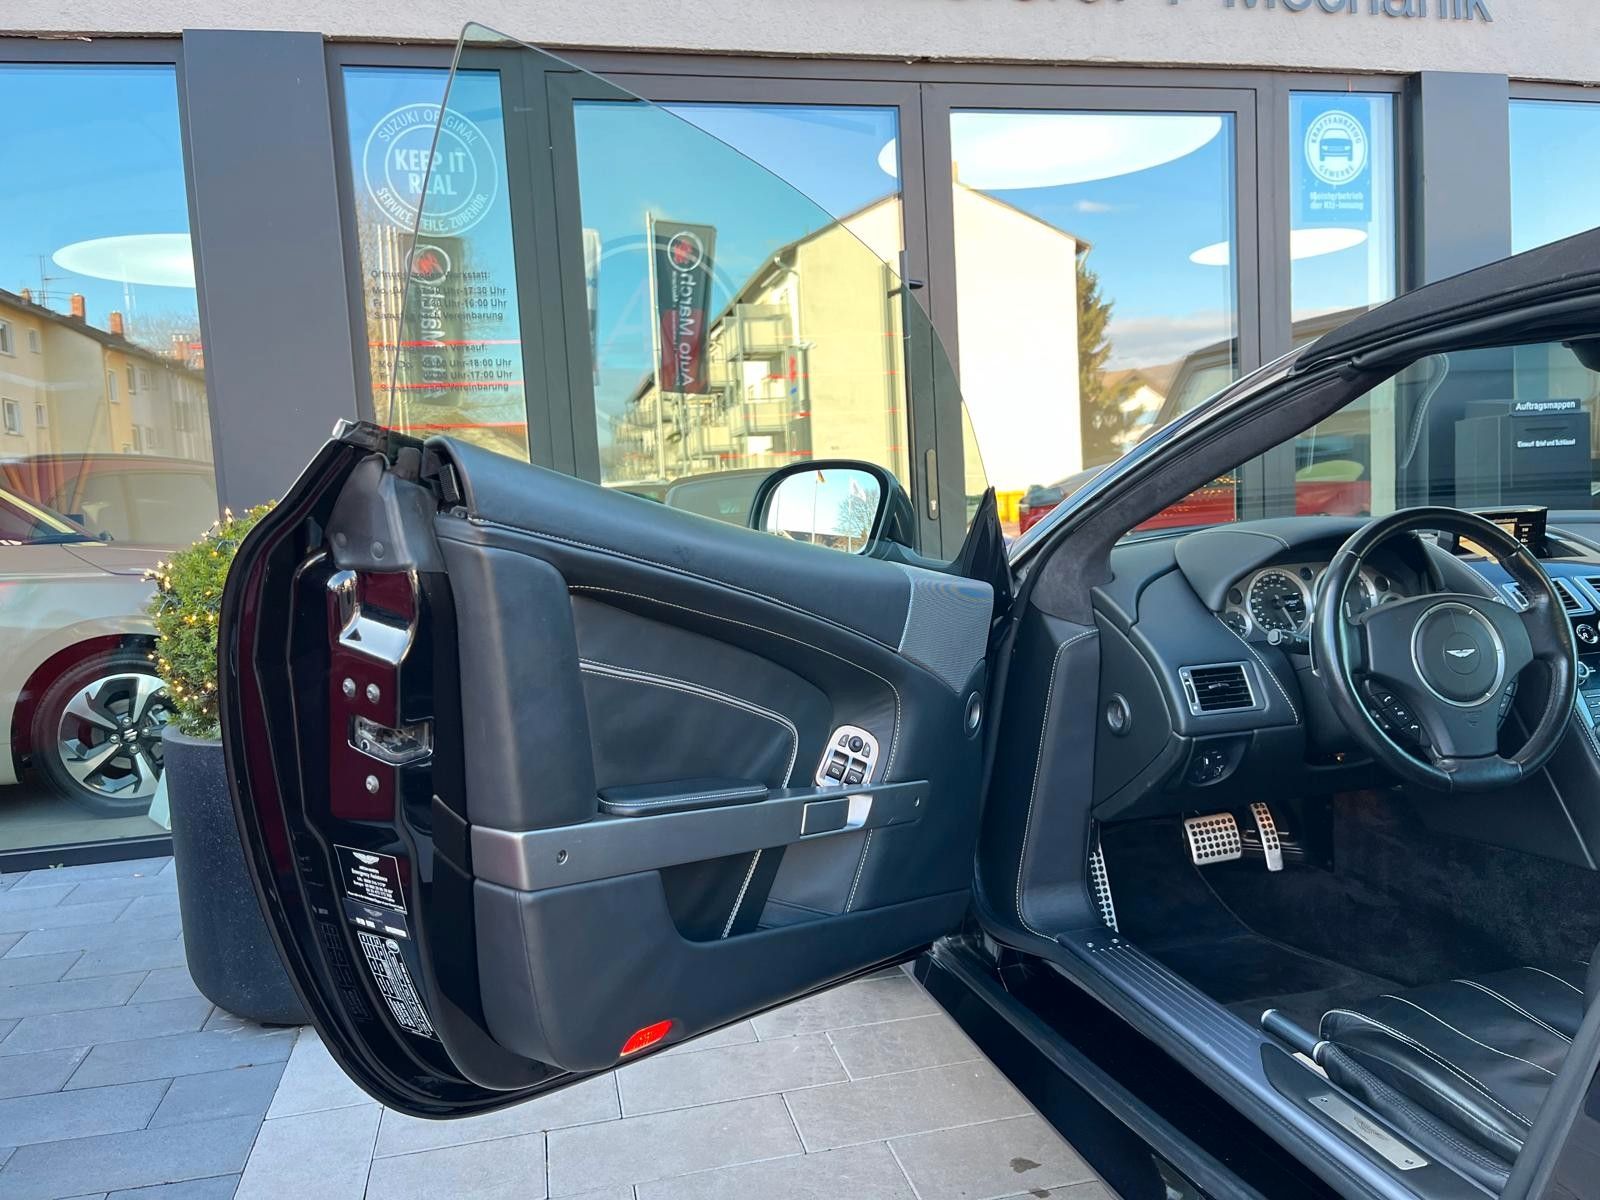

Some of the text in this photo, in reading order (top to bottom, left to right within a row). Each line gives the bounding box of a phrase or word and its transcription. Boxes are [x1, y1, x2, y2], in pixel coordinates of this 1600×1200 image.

[378, 109, 479, 146] SUZUKI ORGINAL
[394, 148, 466, 173] KEEP IT
[490, 286, 507, 295] Uhr
[491, 299, 507, 308] Uhr
[495, 358, 512, 367] Uhr
[497, 370, 513, 379] Uhr
[1515, 401, 1576, 412] Auftragsmappen
